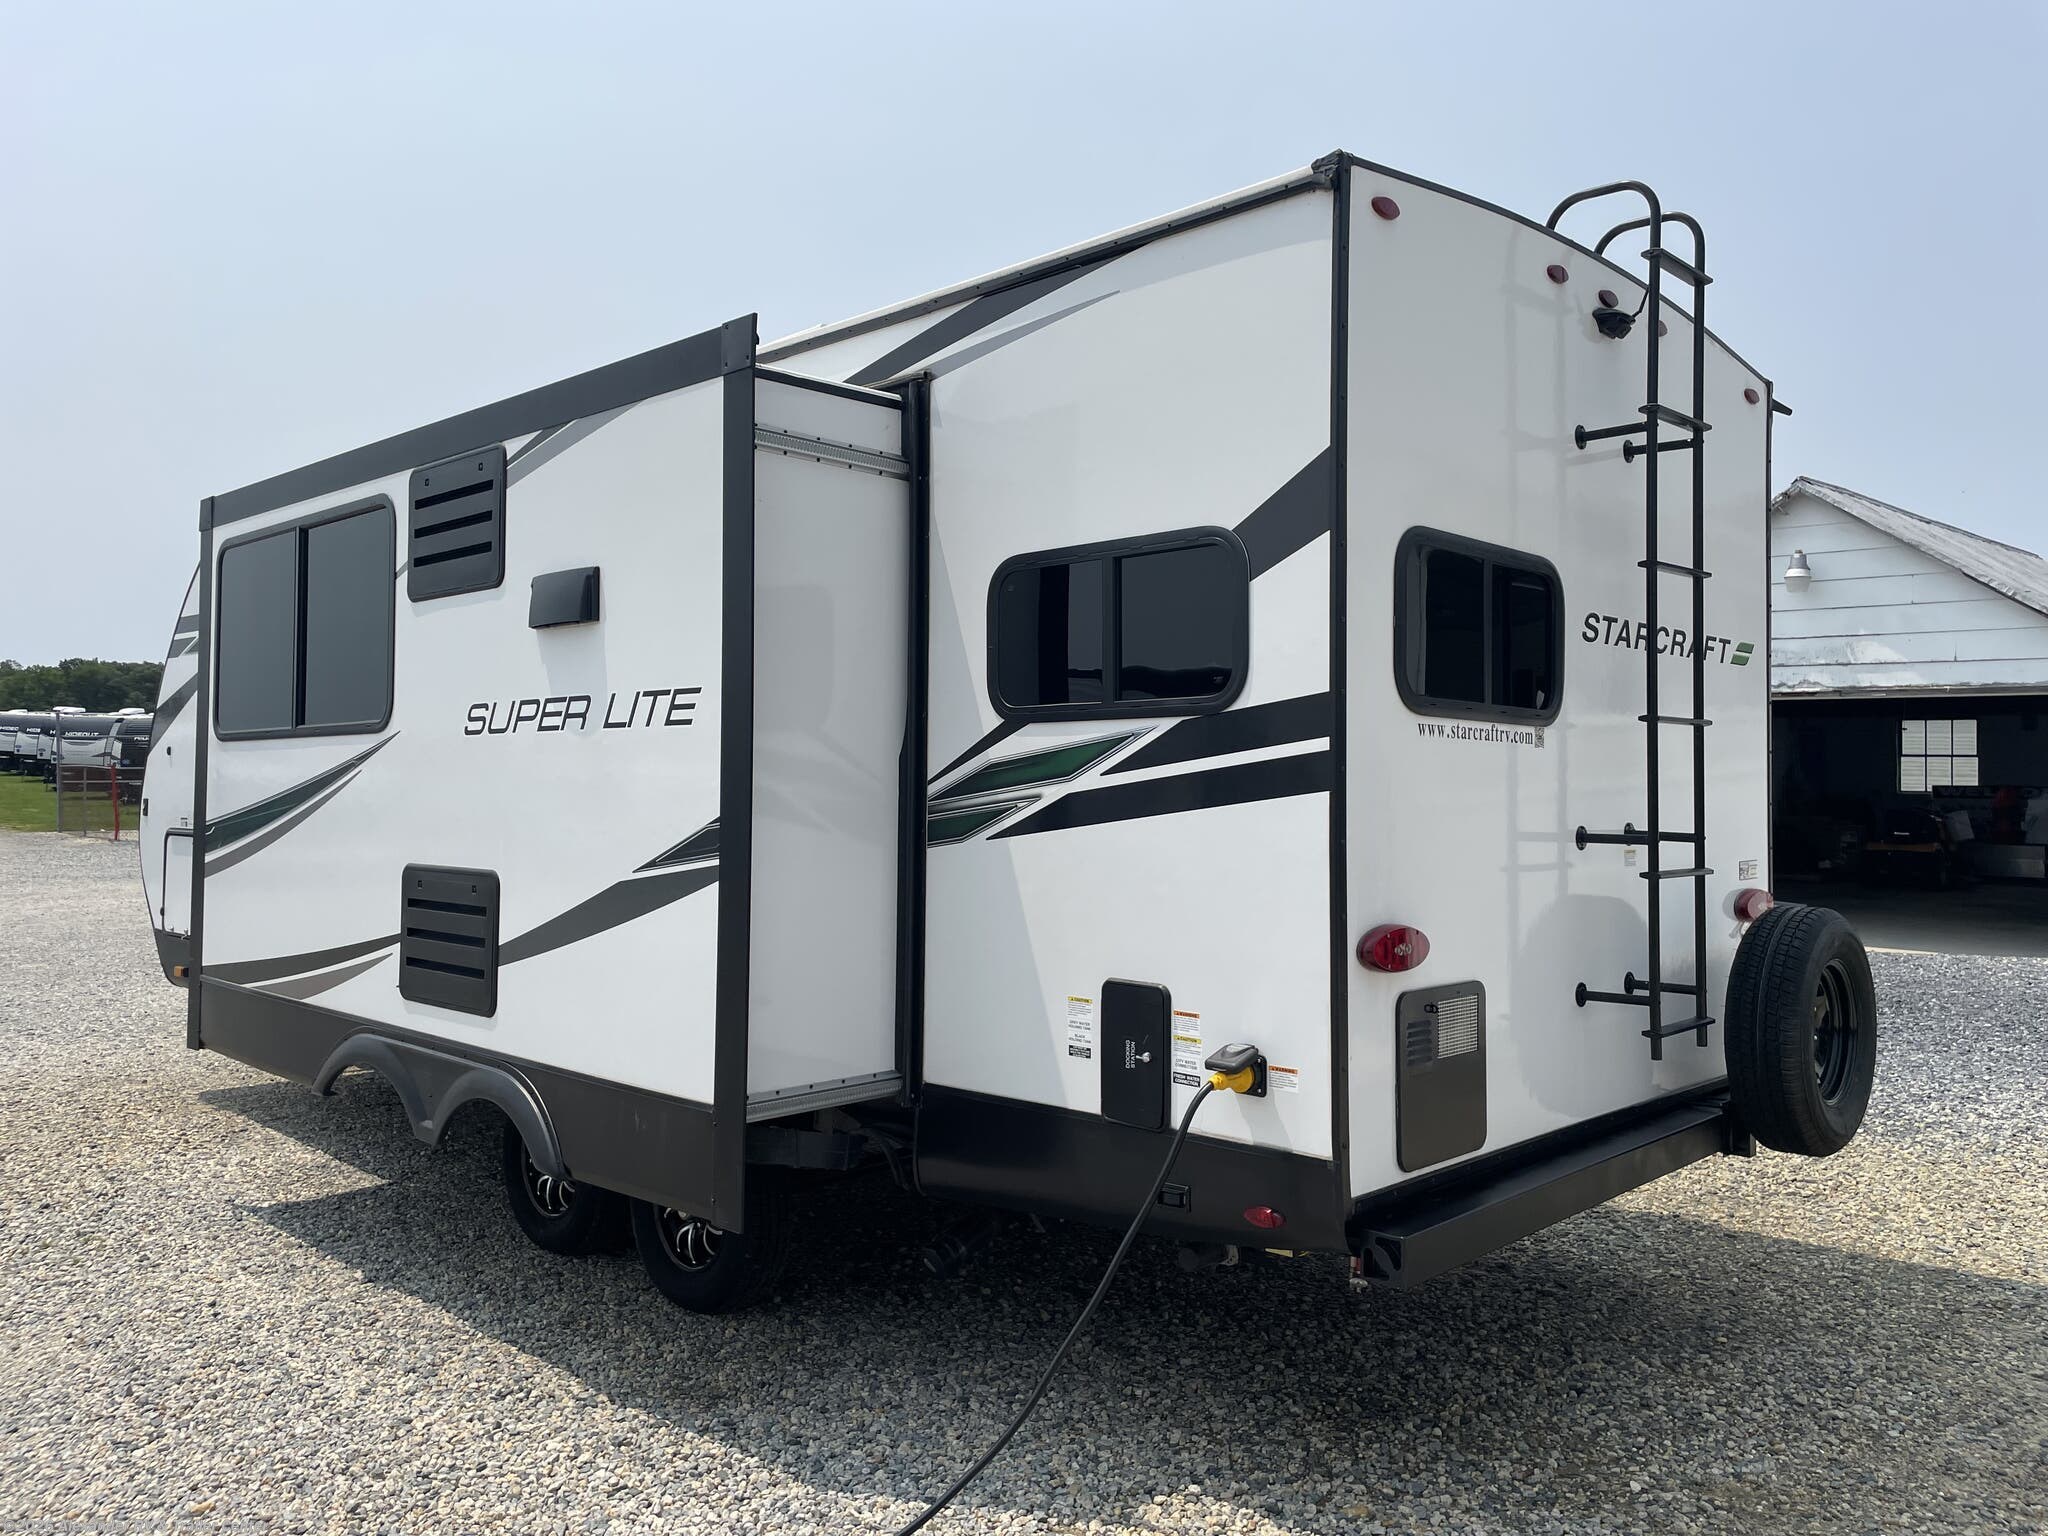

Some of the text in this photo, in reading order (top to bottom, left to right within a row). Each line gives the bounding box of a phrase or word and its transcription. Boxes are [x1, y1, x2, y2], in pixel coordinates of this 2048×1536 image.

[464, 687, 703, 736] SUPER LITE
[1417, 722, 1533, 745] www.starcraftrv.com
